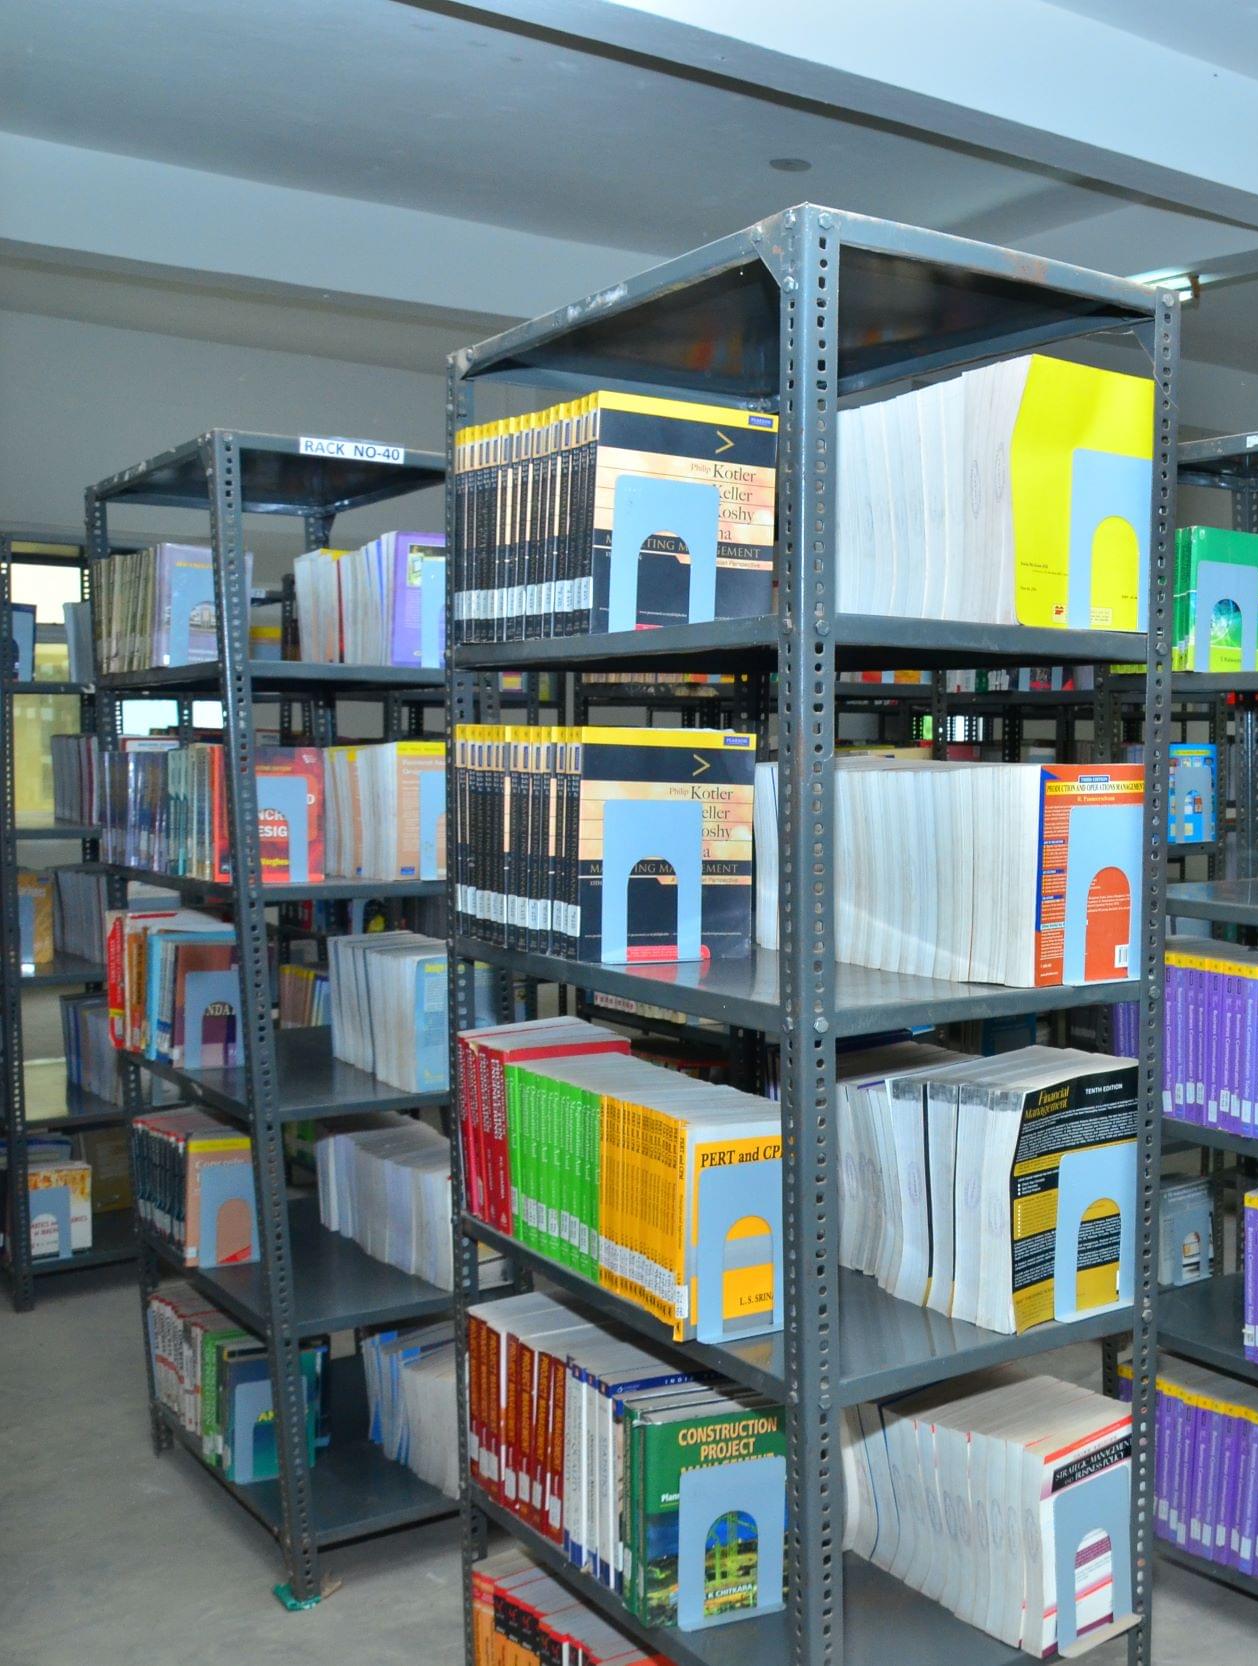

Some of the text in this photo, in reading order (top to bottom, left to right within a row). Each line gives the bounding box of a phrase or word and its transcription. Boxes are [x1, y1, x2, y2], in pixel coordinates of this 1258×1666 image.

[304, 440, 400, 461] RACK NO-40
[713, 464, 756, 482] Kotler
[669, 786, 733, 800] Philip Kotler
[1115, 782, 1144, 791] MANAGEMEN
[702, 806, 731, 820] eller
[258, 825, 288, 837] ESIG
[702, 824, 733, 841] oshy
[1039, 1085, 1070, 1105] Financial
[1085, 1083, 1123, 1095] TENTH EDITION
[1025, 1099, 1068, 1119] Management
[700, 1144, 783, 1168] PERT and CP
[678, 1416, 777, 1446] CONSTRUCTION
[700, 1437, 756, 1461] PROJECT
